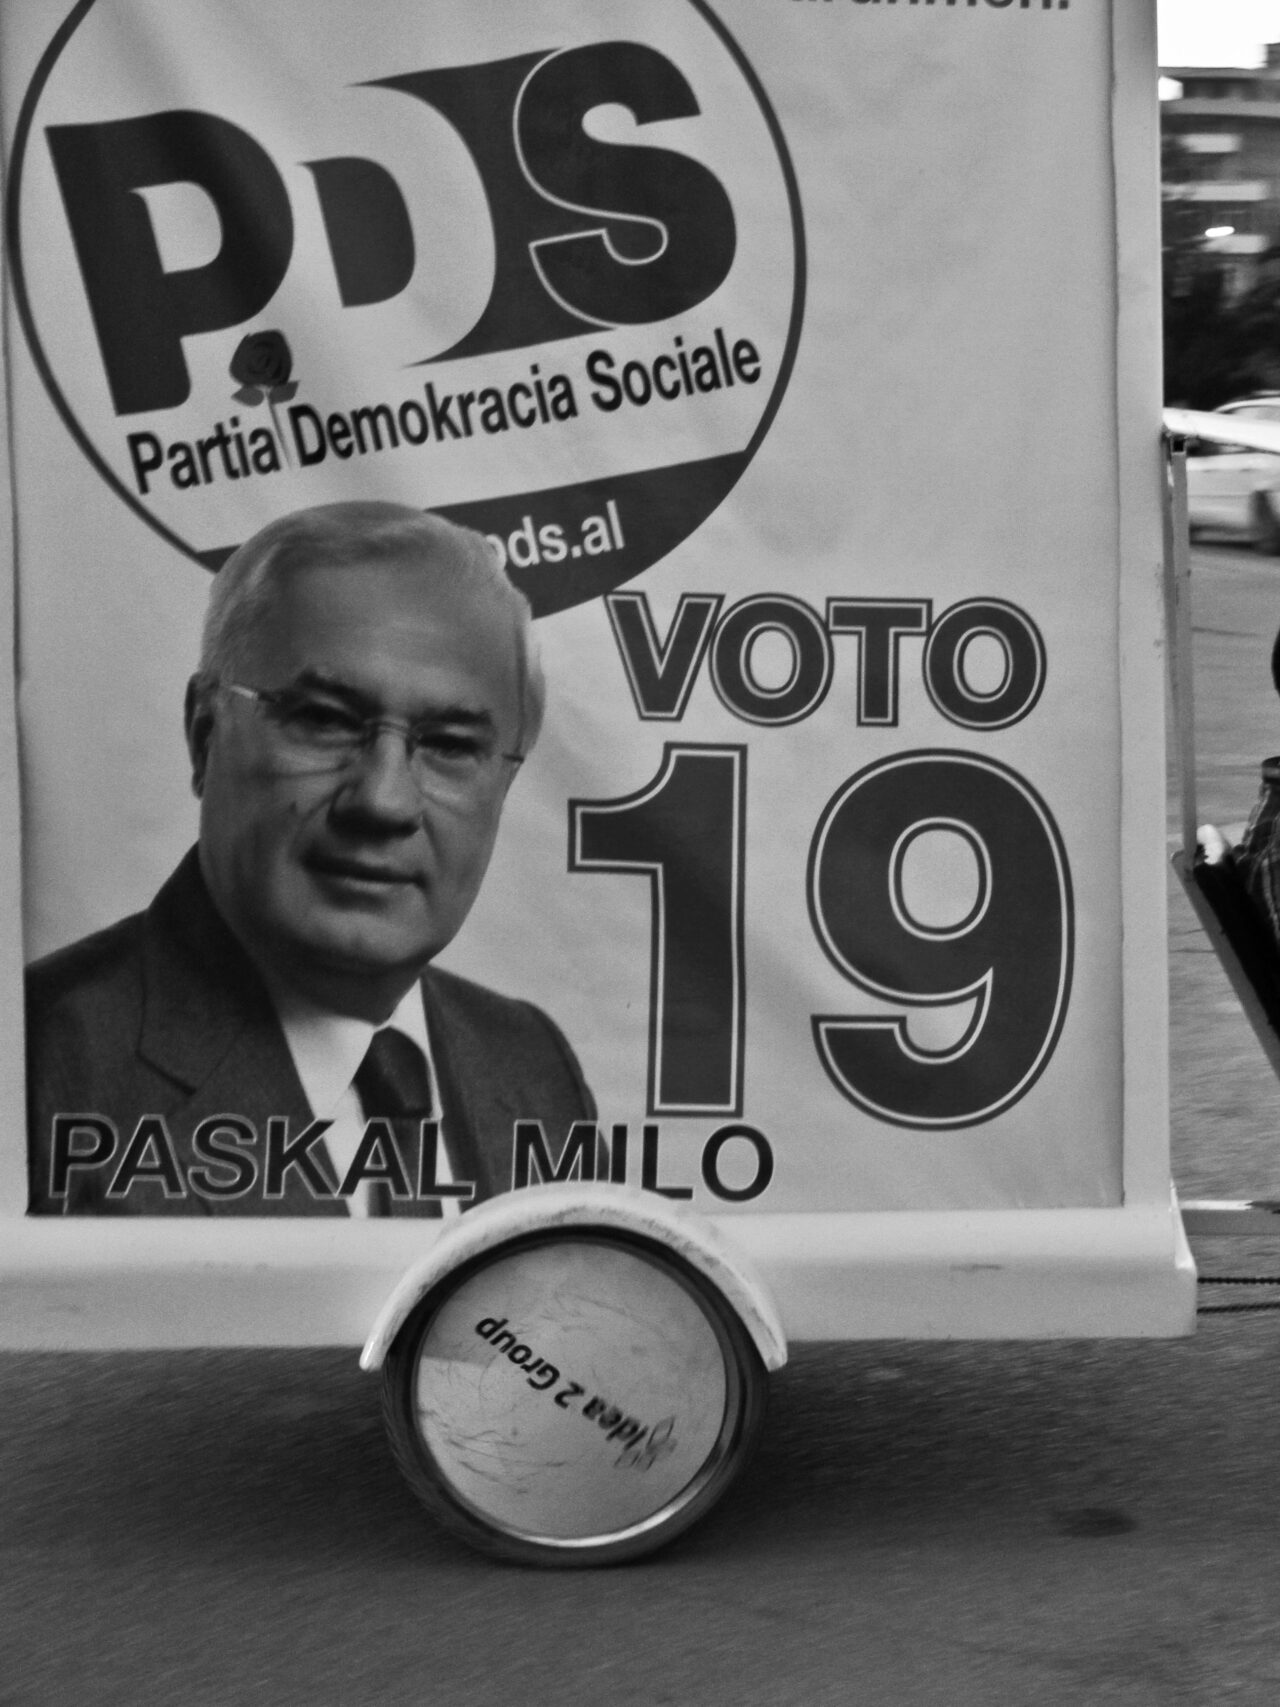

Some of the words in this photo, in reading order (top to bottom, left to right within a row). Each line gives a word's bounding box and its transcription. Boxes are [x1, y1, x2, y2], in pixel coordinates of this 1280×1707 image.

[44, 39, 738, 417] PDS
[126, 414, 281, 495] Partia
[288, 363, 578, 468] Demokracia
[586, 327, 764, 412] Sociale
[603, 591, 1047, 732] VOTO
[567, 741, 1076, 1131] 19
[48, 1112, 477, 1201] PASKAL
[511, 1119, 774, 1203] MILO
[474, 1317, 560, 1391] Group
[553, 1380, 585, 1409] 2
